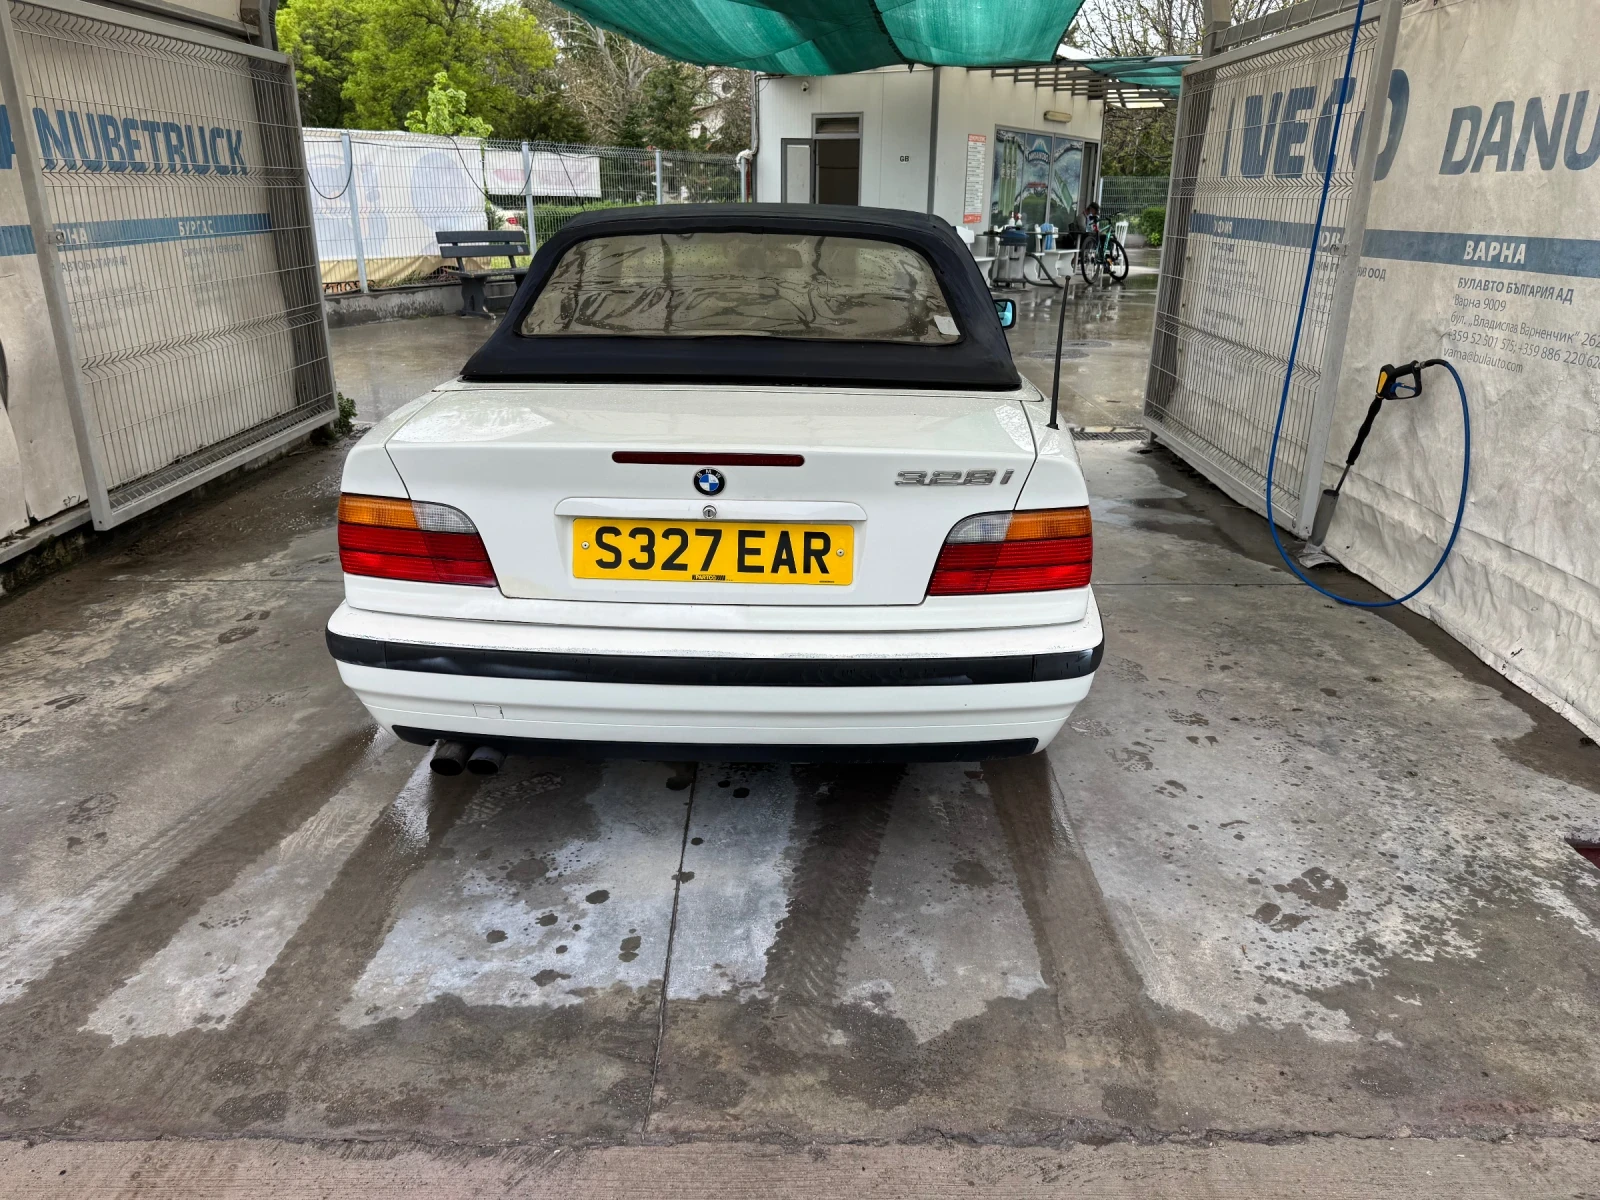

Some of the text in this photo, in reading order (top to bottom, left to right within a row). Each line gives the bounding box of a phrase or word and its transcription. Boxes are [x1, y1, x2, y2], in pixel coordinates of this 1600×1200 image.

[899, 155, 910, 163] GB
[178, 220, 213, 237] БУРГАС
[1463, 240, 1527, 265] ВАРНА
[1367, 267, 1387, 283] ООД
[1457, 277, 1575, 305] БУЛАВТО БЪЛГАРИЯ АД
[1454, 294, 1507, 312] Варна 9009
[1451, 311, 1466, 326] бул.
[1470, 332, 1482, 346] 52
[1483, 334, 1499, 348] 501
[1541, 346, 1561, 362] 886
[1563, 350, 1586, 366] 220
[1586, 354, 1600, 370] 62
[594, 525, 832, 575] S327 EAR
